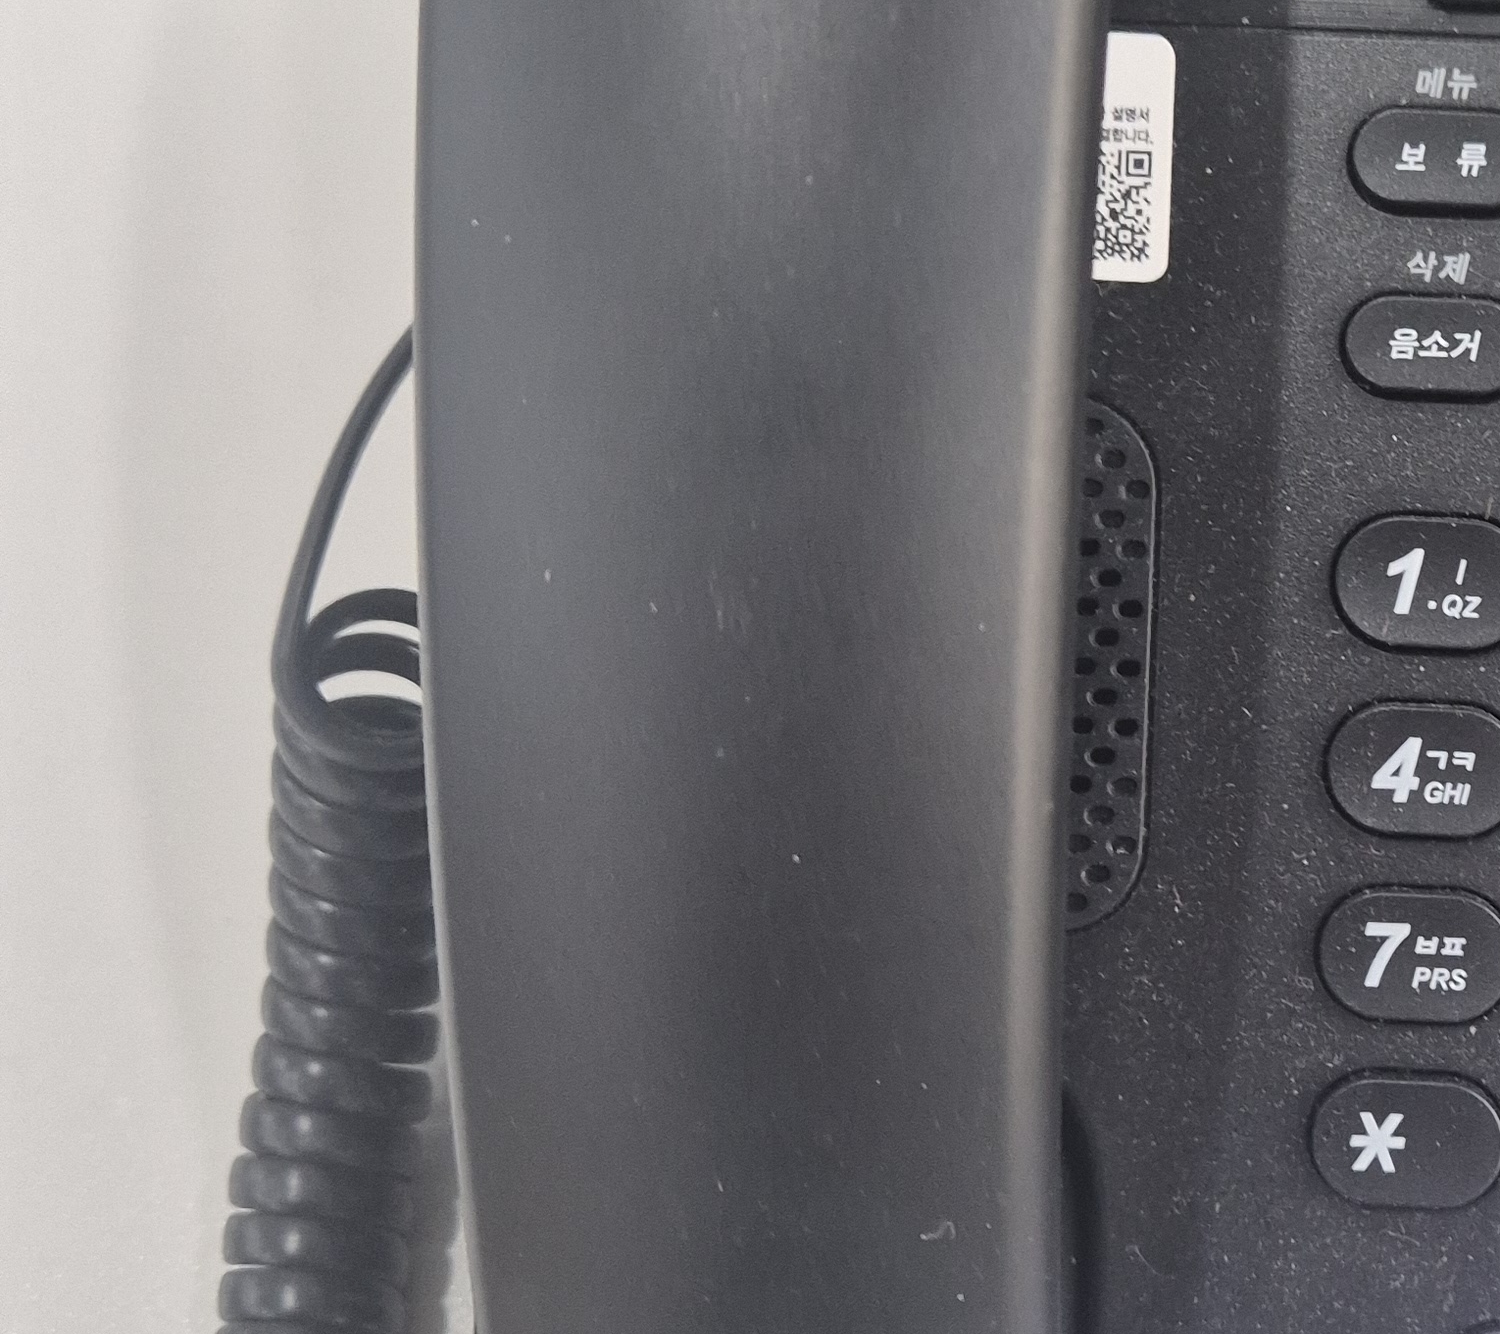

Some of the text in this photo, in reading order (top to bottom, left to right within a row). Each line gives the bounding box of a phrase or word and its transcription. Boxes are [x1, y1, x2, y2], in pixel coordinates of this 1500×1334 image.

[1416, 67, 1477, 100] 메뉴
[1407, 250, 1470, 284] 삭제
[1389, 328, 1481, 362] 음소거
[1387, 548, 1424, 614] 1
[1371, 737, 1422, 803] 4
[1424, 781, 1471, 805] GHI
[1364, 922, 1411, 987] 7
[1412, 967, 1467, 992] PRS
